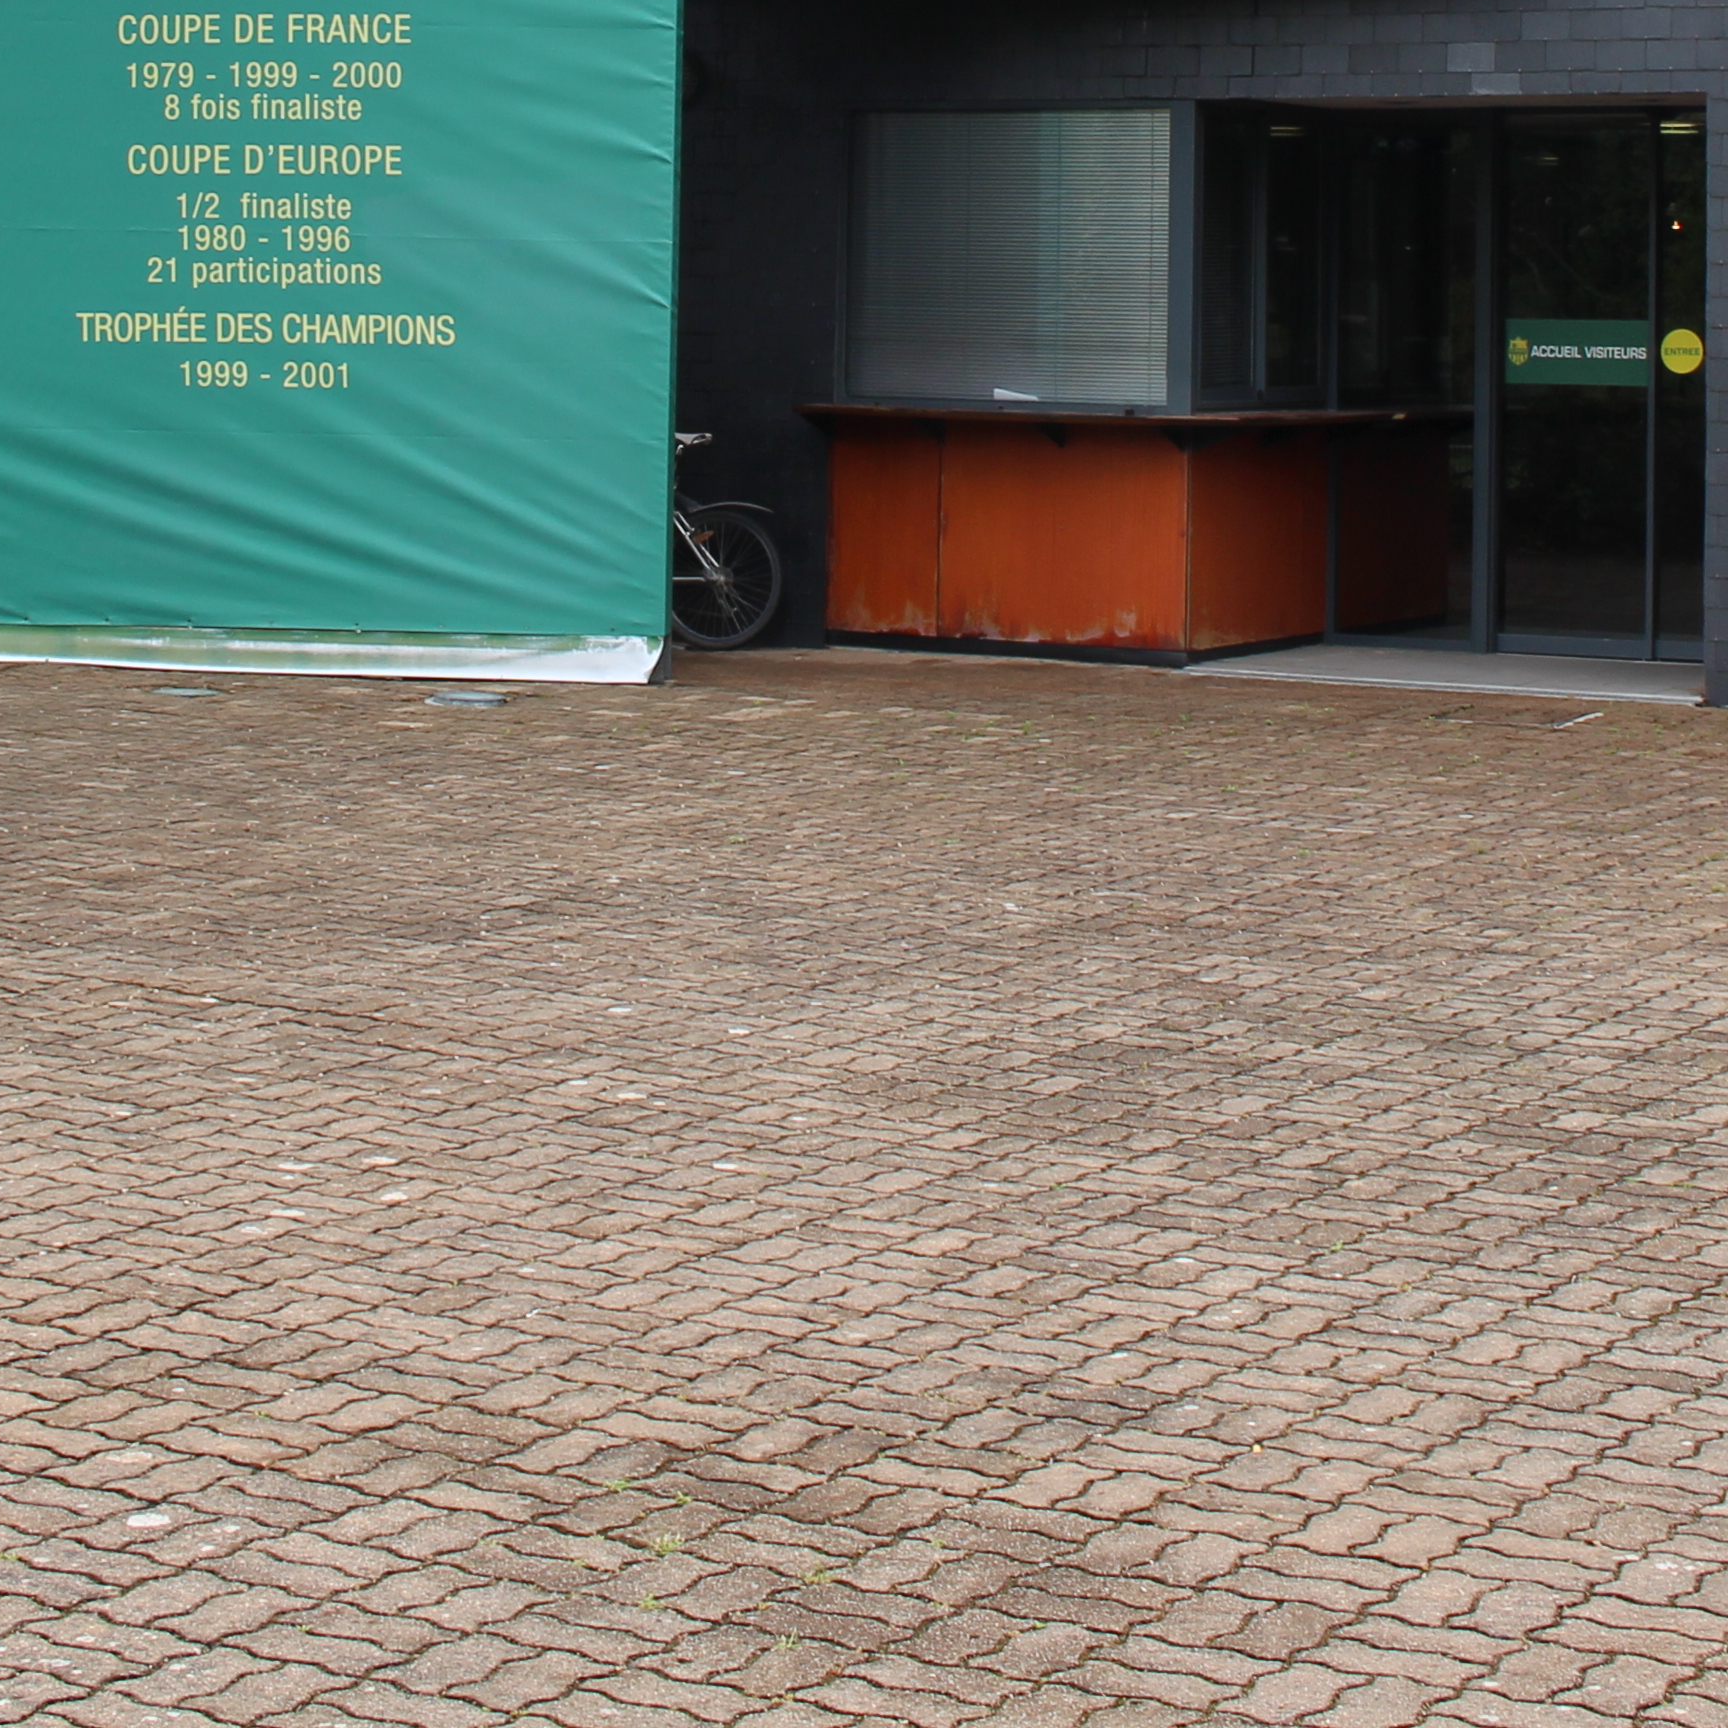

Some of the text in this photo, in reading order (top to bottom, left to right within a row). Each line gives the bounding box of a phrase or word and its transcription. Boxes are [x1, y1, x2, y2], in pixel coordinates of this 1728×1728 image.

[117, 12, 411, 46] COUPE DE FRANCE
[126, 61, 195, 90] 1979
[229, 60, 298, 89] 1999
[331, 61, 402, 89] 2000
[163, 92, 363, 122] 8 fois finaliste
[126, 143, 231, 176] COUPE
[176, 191, 352, 221] 1/2 finaliste
[178, 223, 247, 252] 1980
[282, 224, 351, 253] 1996
[146, 256, 382, 289] 21 participations
[75, 306, 457, 347] TROPHÉE DES CHAMPIONS
[1530, 345, 1582, 358] ACCUEIL
[1584, 346, 1647, 360] VISITEURS
[179, 360, 249, 389] 1999
[282, 361, 349, 390] 2001
